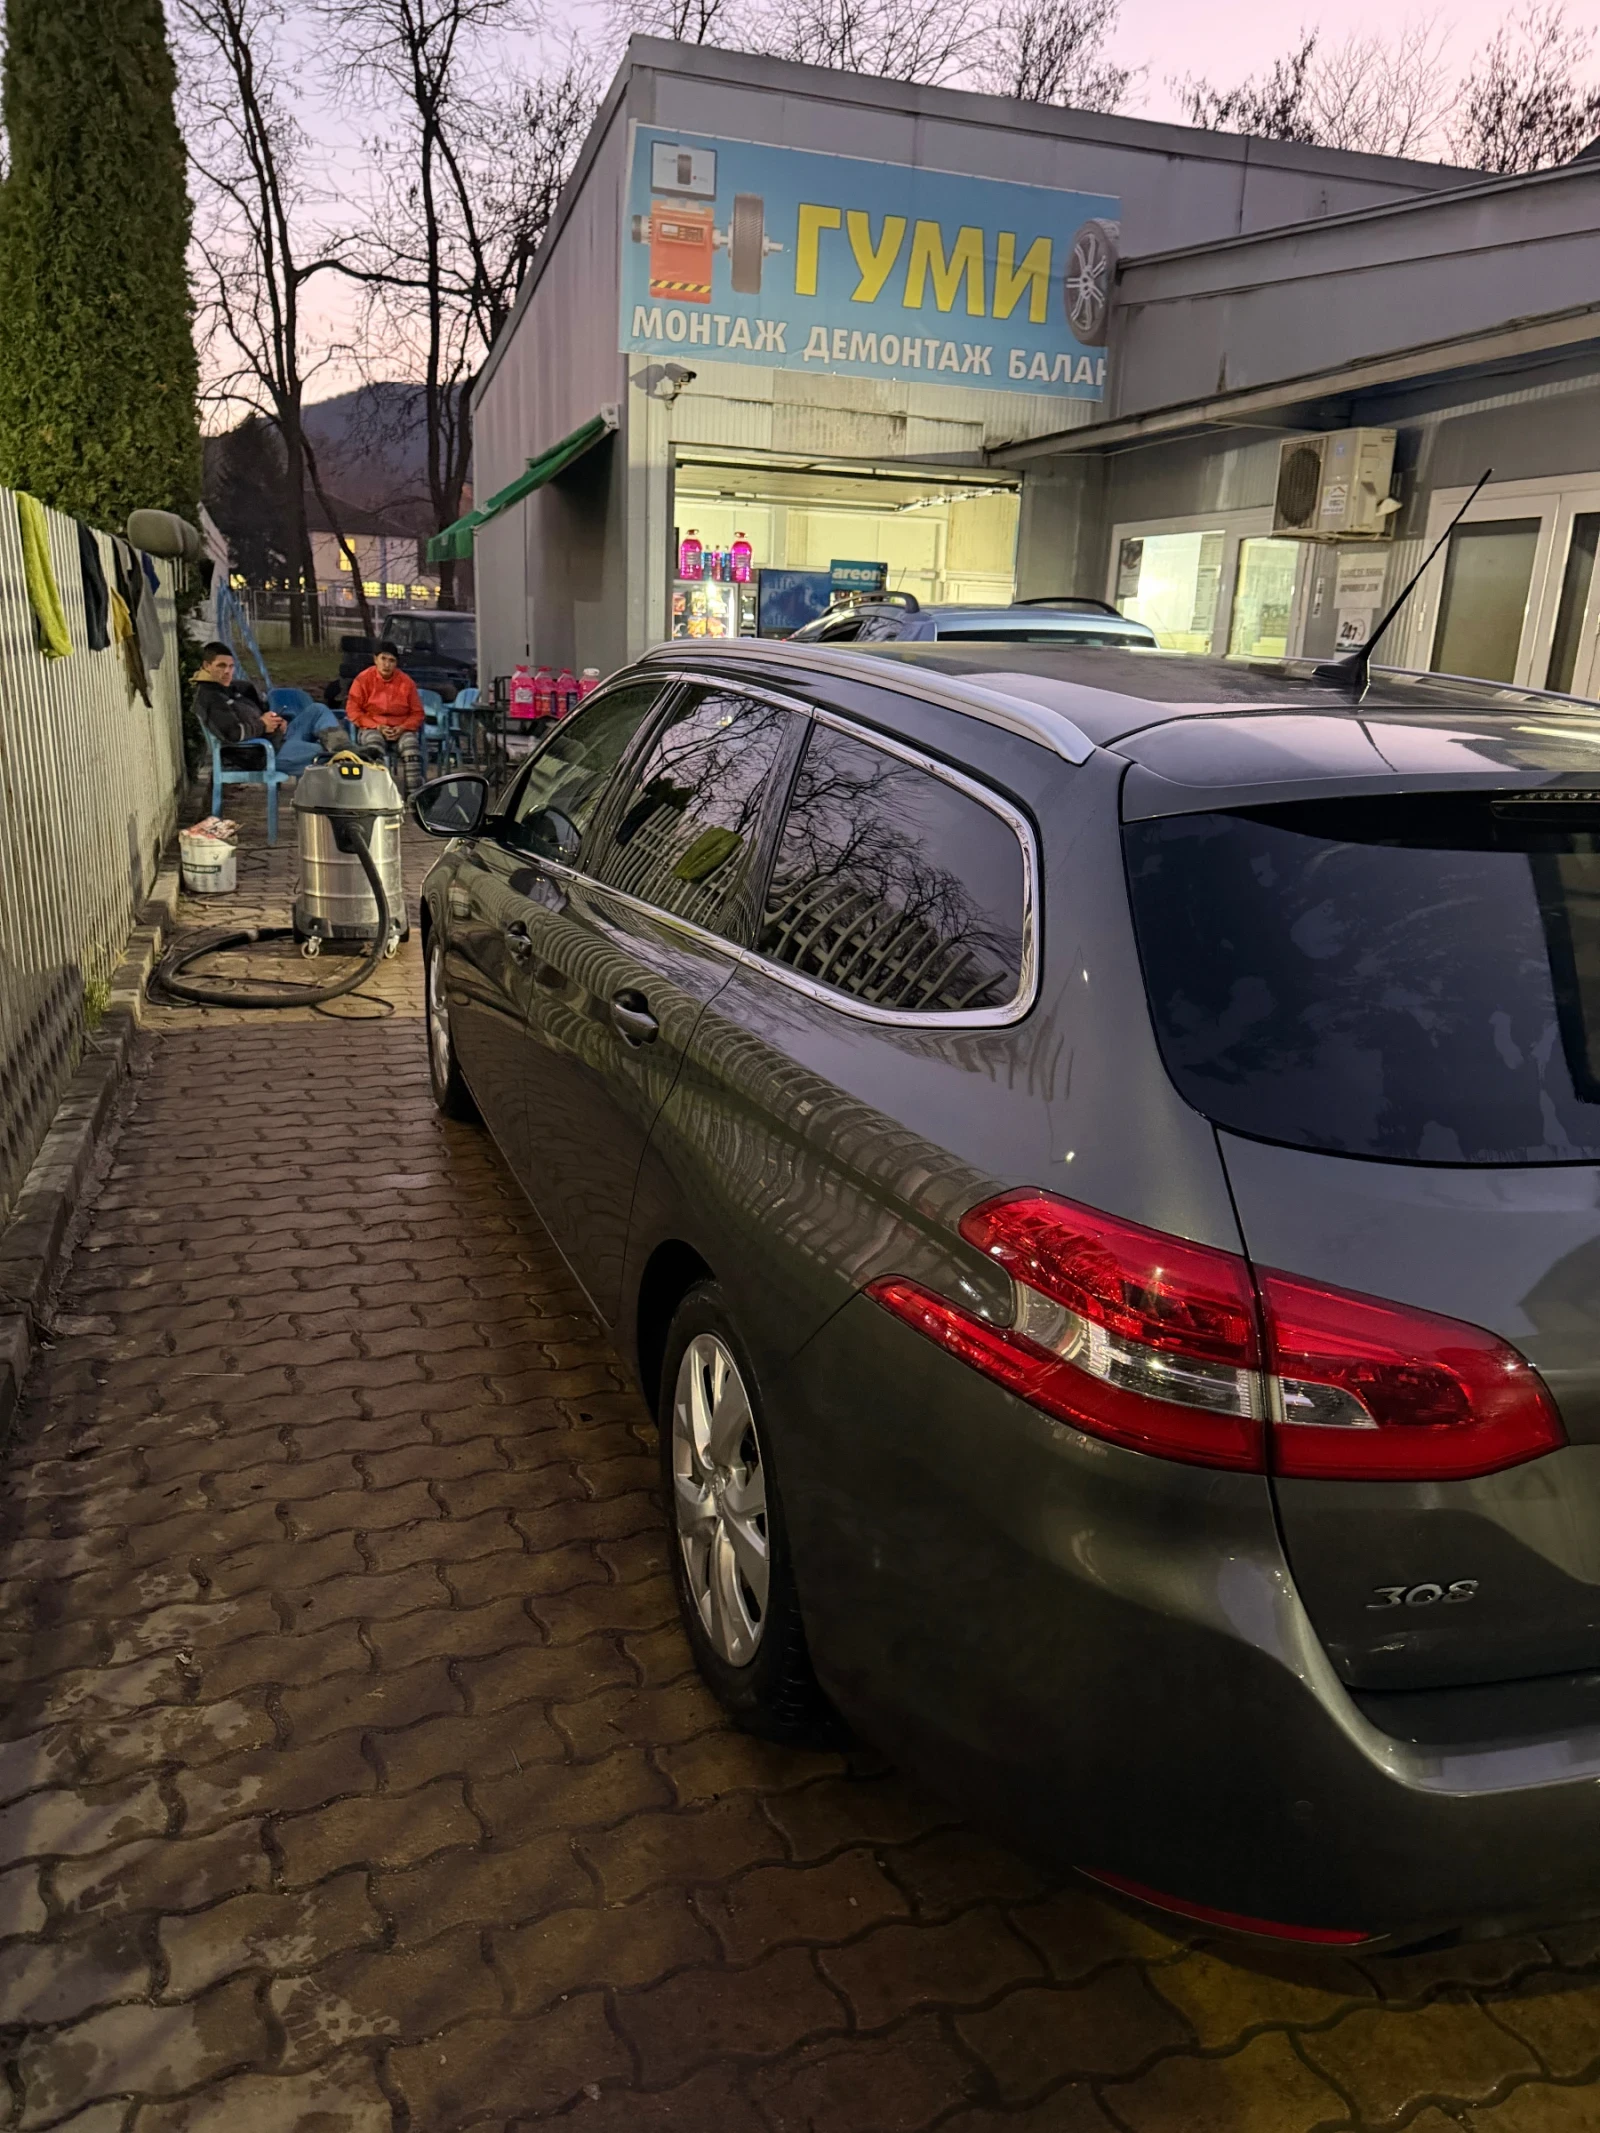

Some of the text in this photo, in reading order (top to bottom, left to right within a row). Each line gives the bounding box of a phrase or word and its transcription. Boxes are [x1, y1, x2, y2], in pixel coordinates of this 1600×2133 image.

[794, 203, 1054, 325] ГУМИ
[632, 304, 788, 354] МОНТАЖ
[803, 325, 994, 377] ДЕМОНТАЖ
[832, 567, 881, 581] areon
[1365, 1579, 1479, 1610] 308
